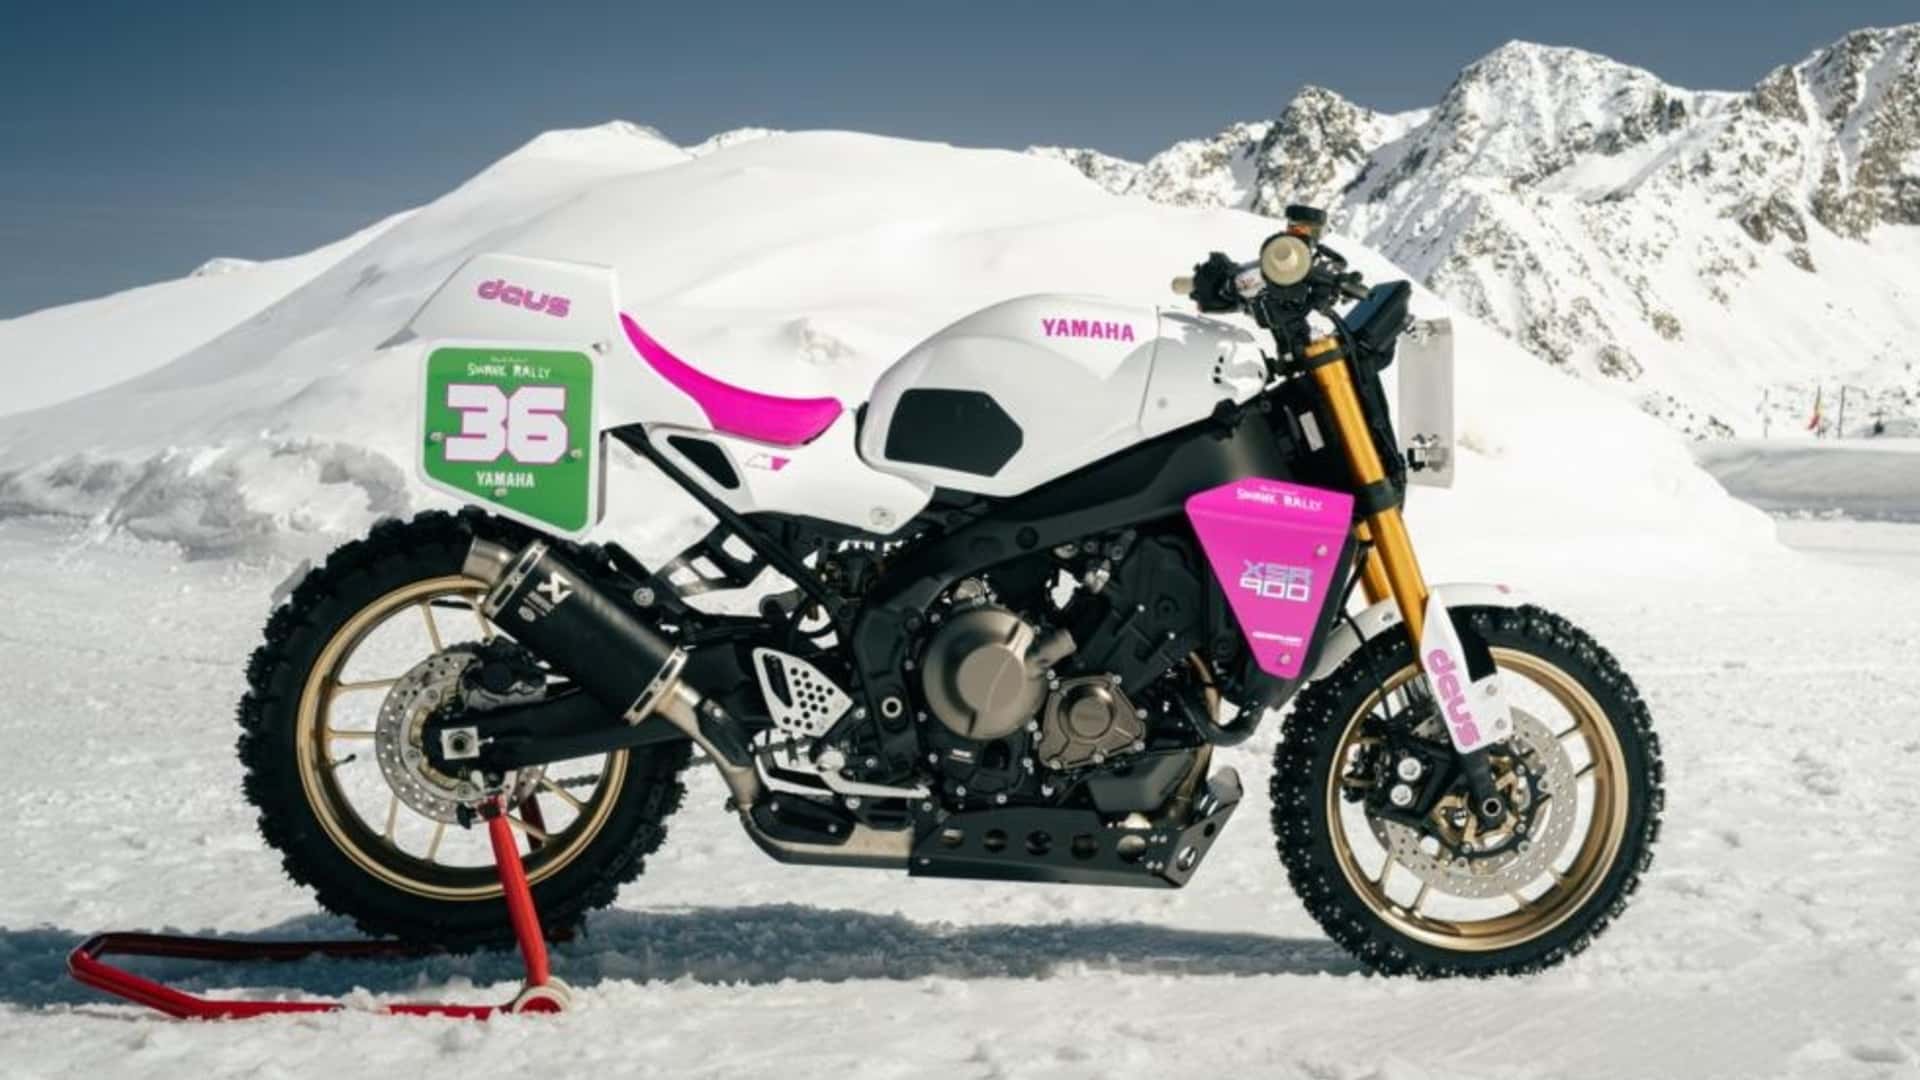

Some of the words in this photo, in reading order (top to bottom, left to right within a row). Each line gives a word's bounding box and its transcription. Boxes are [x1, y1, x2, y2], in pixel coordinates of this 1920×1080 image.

[1041, 318, 1135, 342] YAMAHA
[513, 364, 552, 379] RALLY
[444, 383, 569, 464] 36
[476, 471, 535, 488] YAMAHA
[1240, 577, 1310, 603] 900
